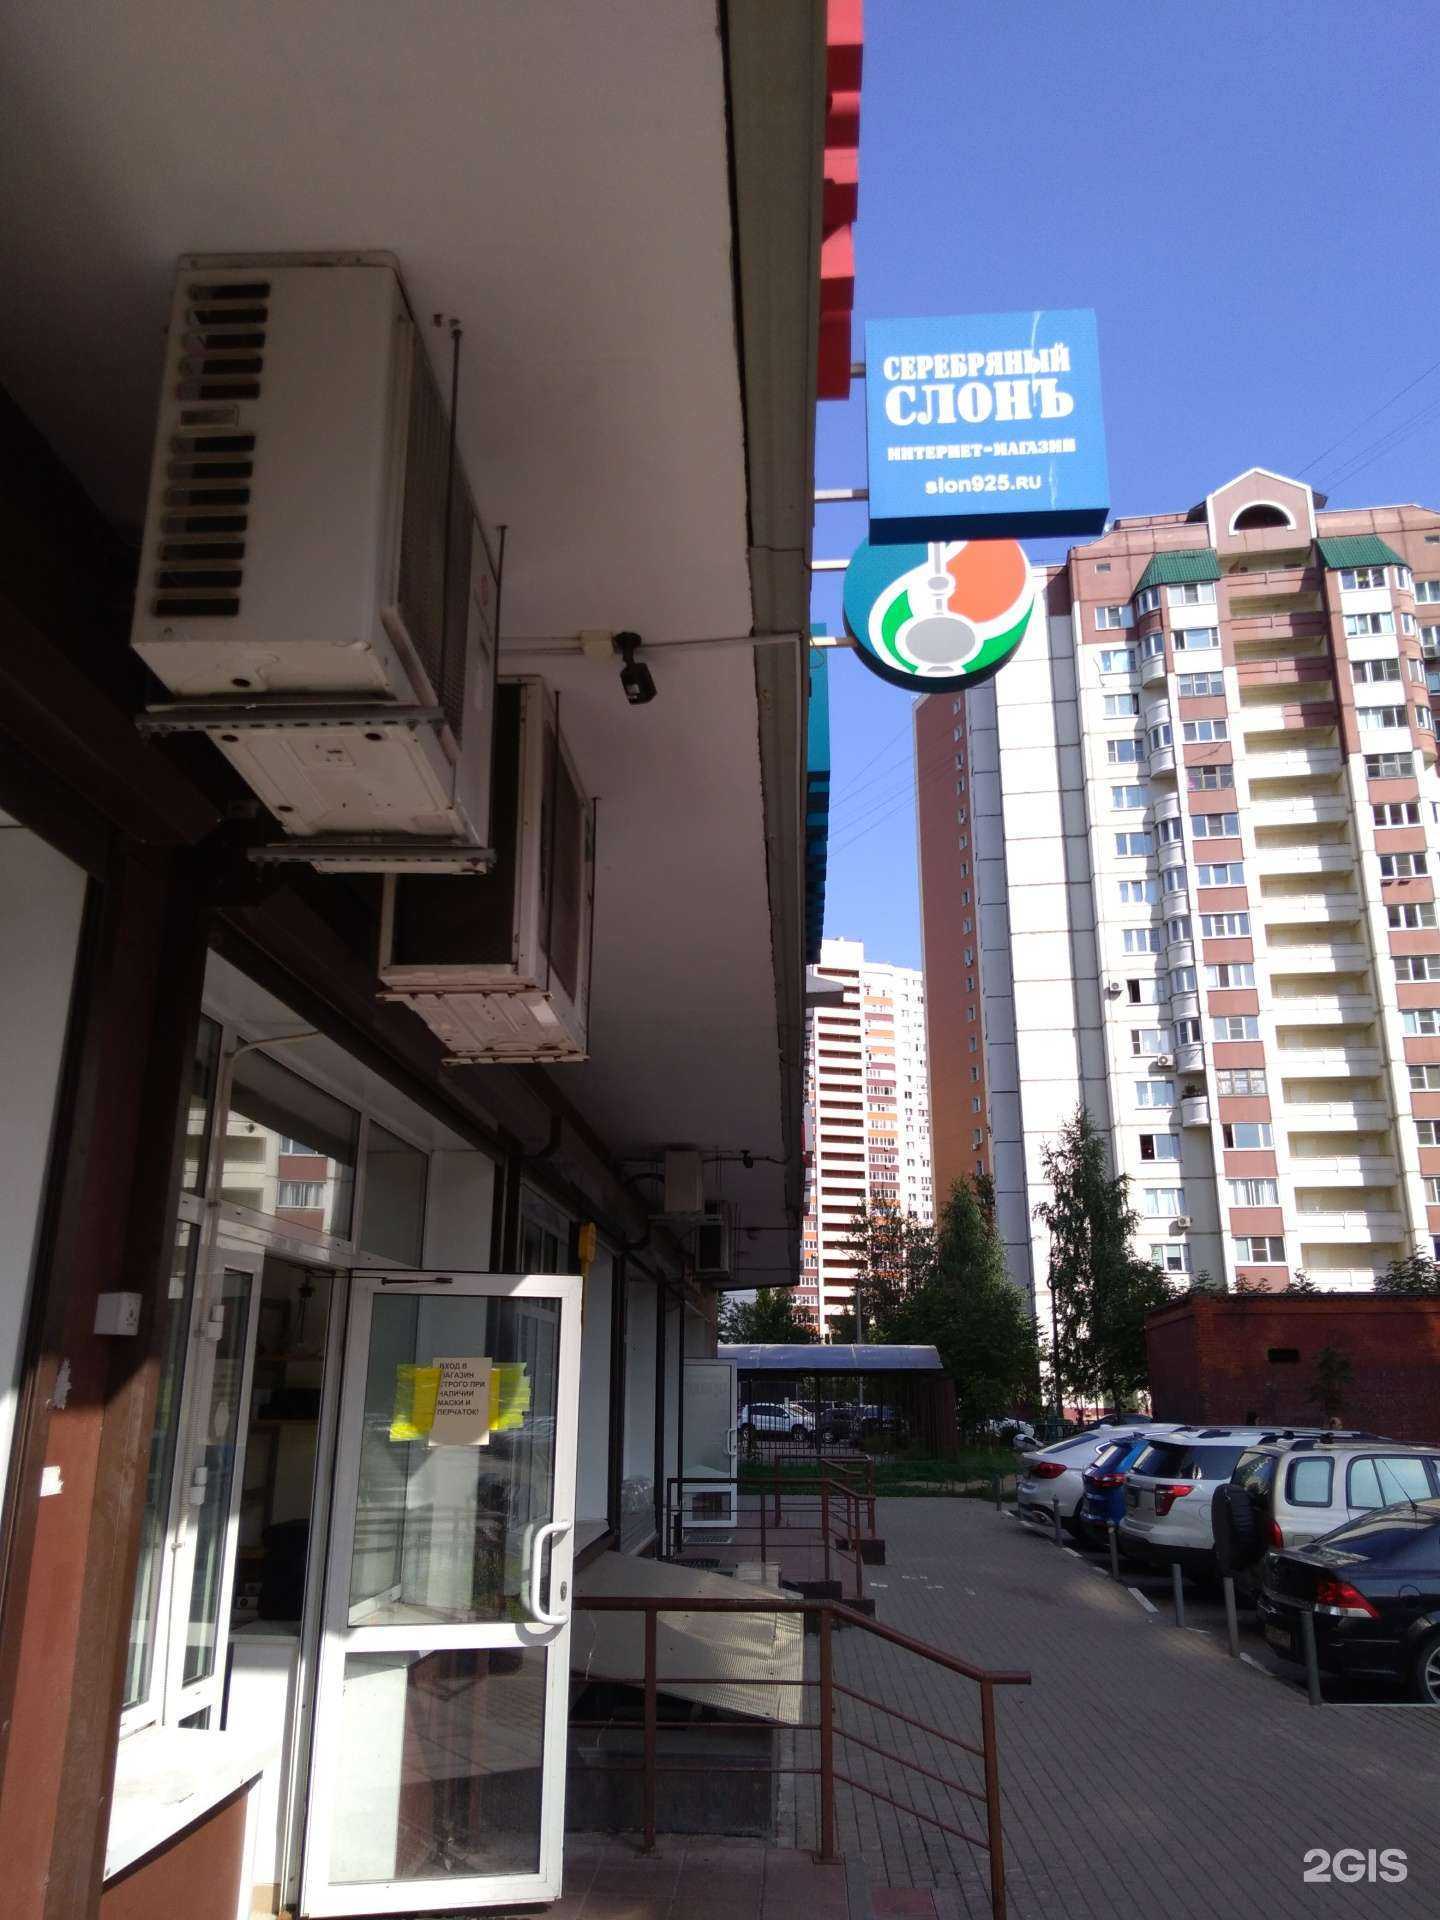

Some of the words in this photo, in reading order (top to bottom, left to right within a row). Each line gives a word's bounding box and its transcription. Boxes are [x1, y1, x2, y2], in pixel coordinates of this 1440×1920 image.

[883, 342, 1071, 381] СЕРЕБРЯНЫЙ
[885, 378, 1074, 426] СЛОНЪ
[888, 438, 1076, 461] ИНТЕРНЕТ-МАГАЗИН
[440, 1362, 460, 1370] ВХОД
